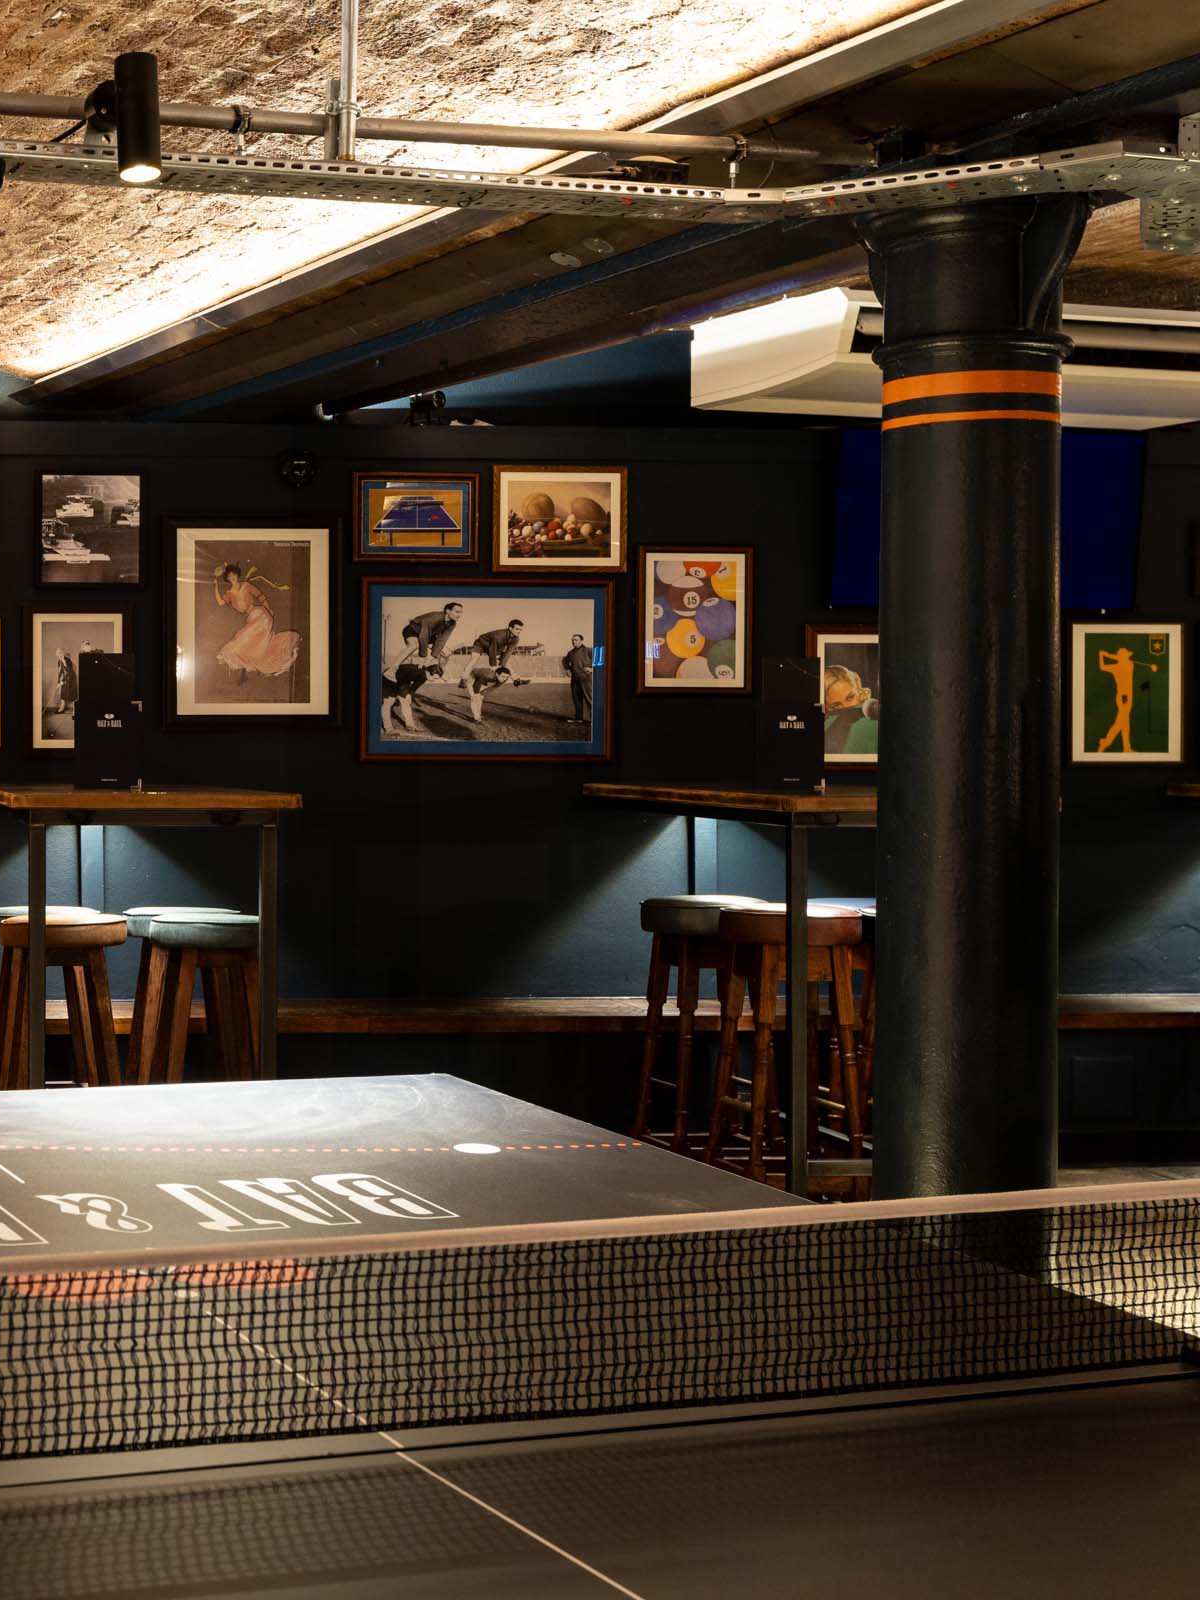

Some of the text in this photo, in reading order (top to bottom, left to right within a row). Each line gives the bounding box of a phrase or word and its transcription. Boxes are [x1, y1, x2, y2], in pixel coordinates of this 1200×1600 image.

[686, 595, 698, 606] 15
[689, 634, 697, 645] 5
[35, 1192, 153, 1234] &
[156, 1172, 460, 1233] BAT
